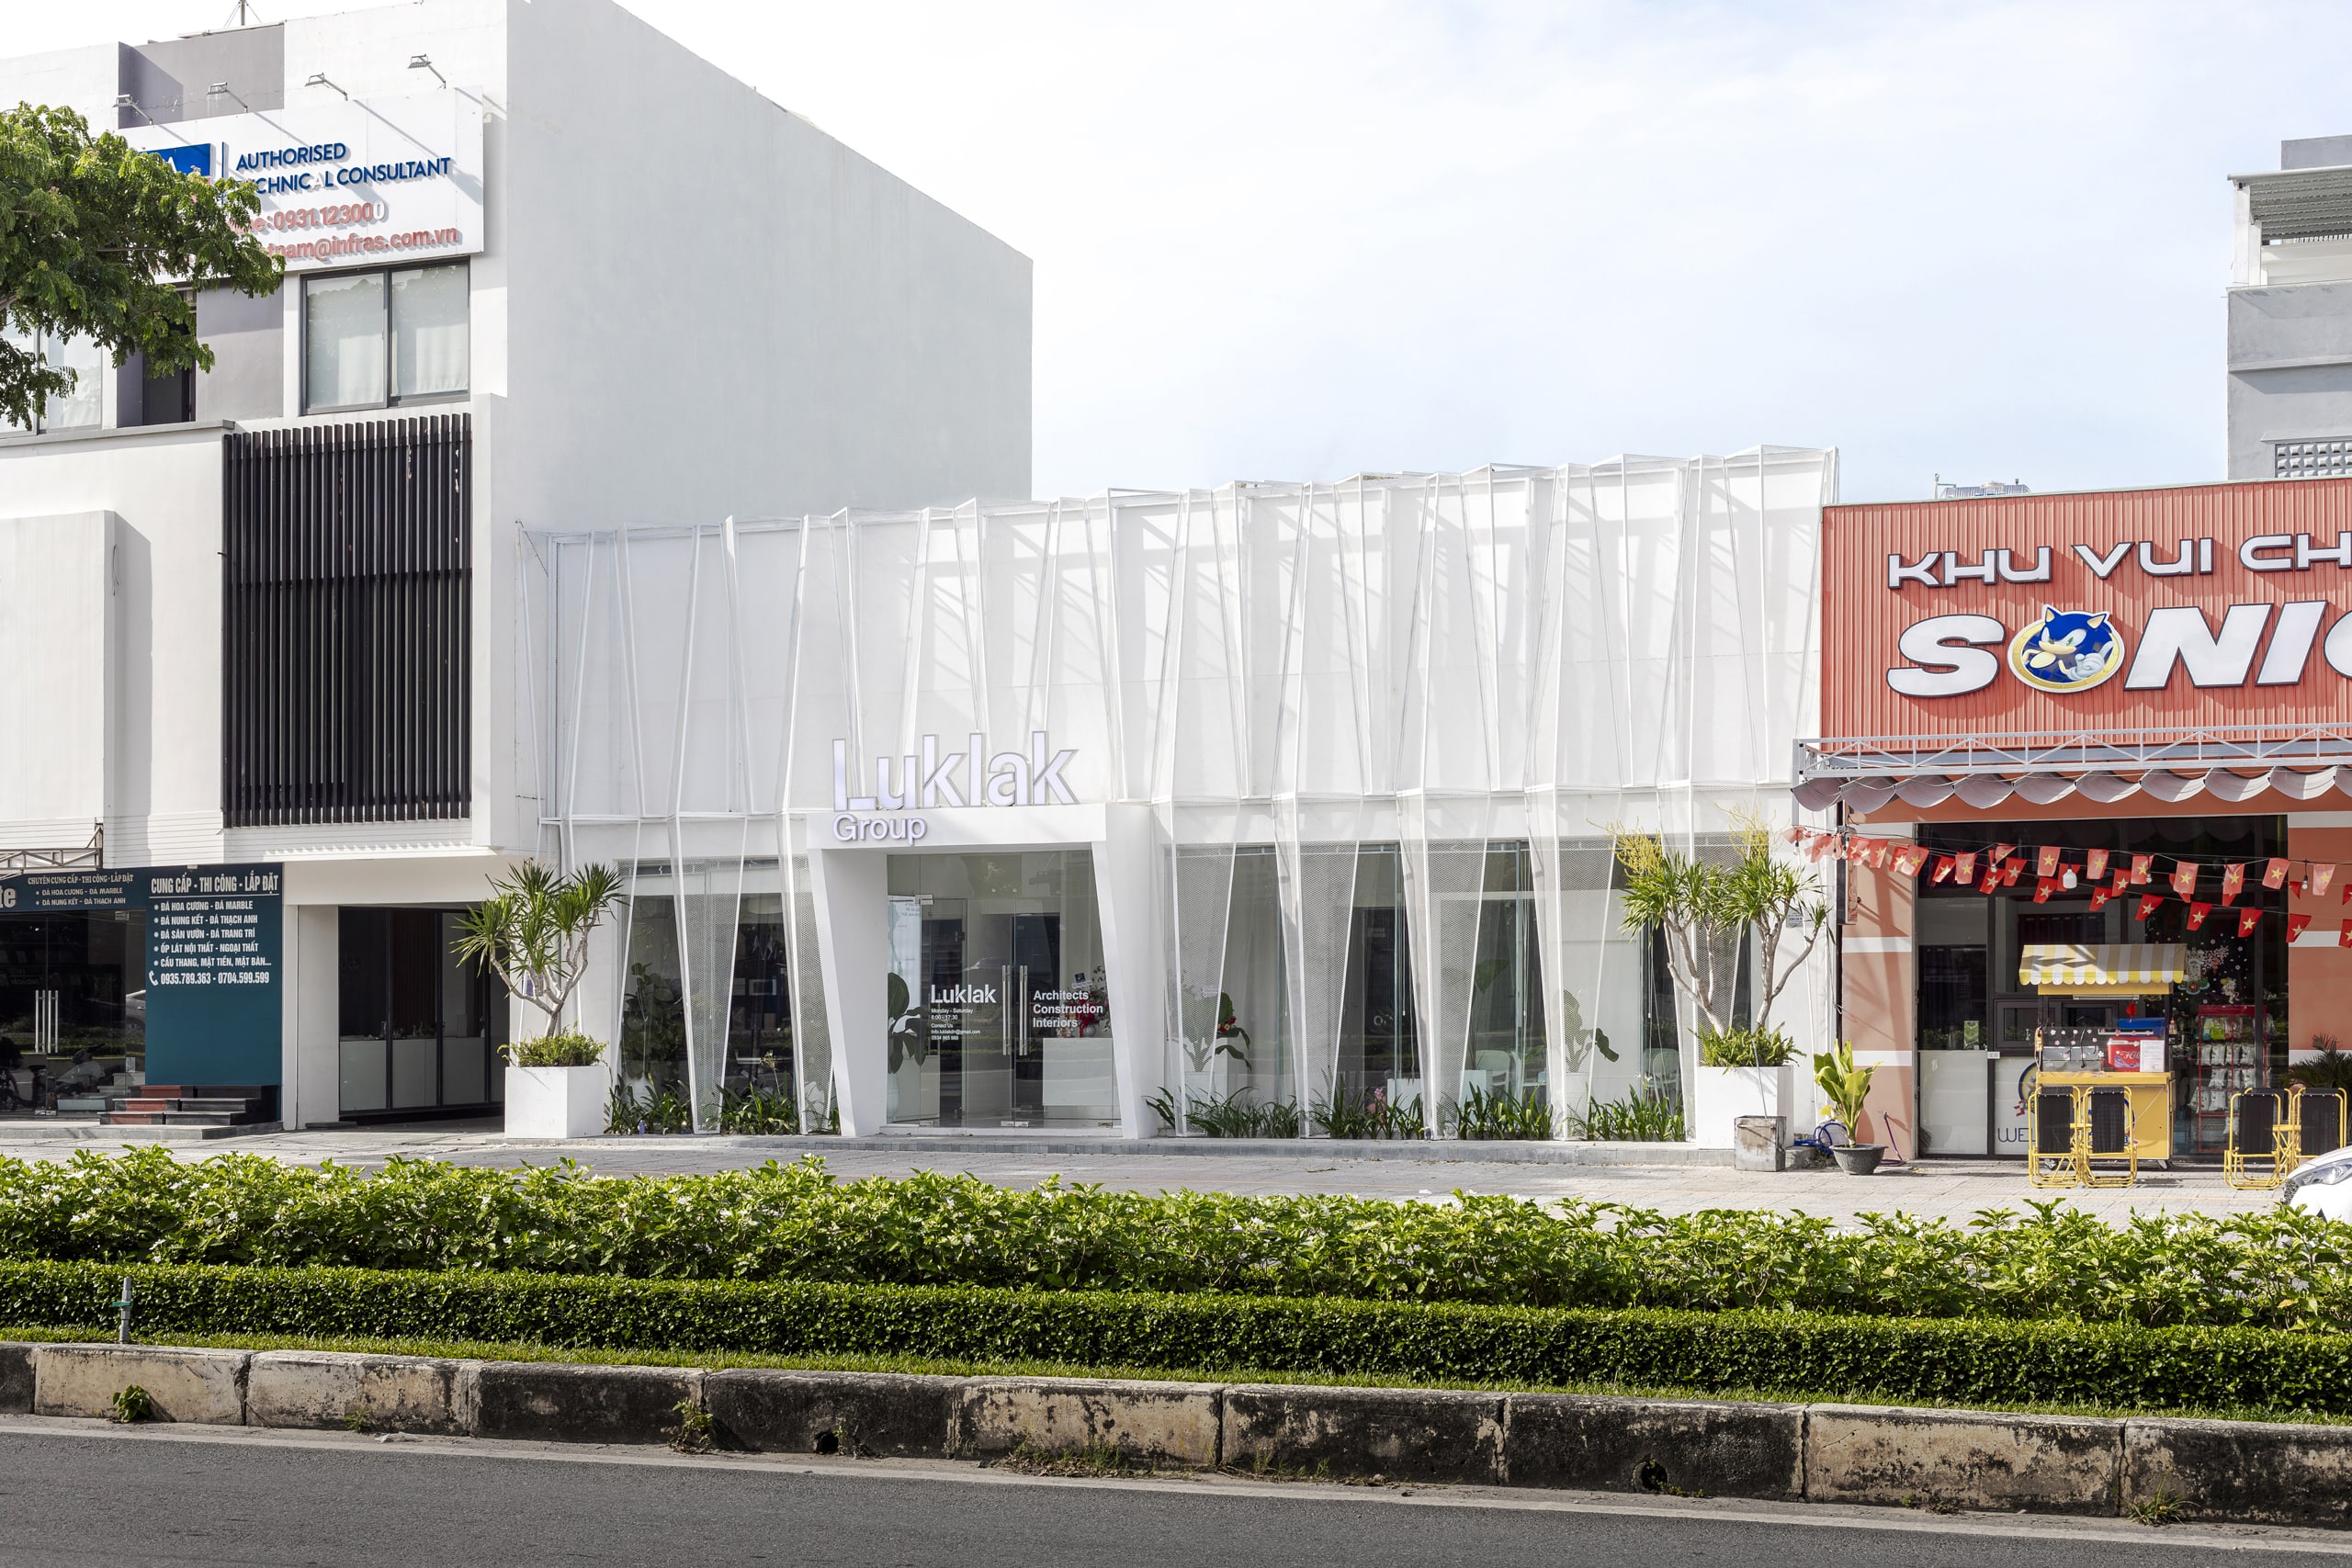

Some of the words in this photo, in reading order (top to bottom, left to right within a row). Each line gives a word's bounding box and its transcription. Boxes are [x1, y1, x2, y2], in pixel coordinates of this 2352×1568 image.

[236, 142, 346, 171] AUTHORISED
[238, 172, 334, 194] CHNICAL
[336, 157, 450, 186] CONSULTANT
[267, 226, 457, 261] tnam@infras.com.vn
[1887, 546, 2052, 589] KHU
[2072, 537, 2213, 580] VUI
[832, 731, 1079, 812] Luklak
[831, 813, 927, 845] Group
[151, 877, 174, 894] CUNG
[175, 872, 192, 893] CẤP
[199, 876, 212, 892] THI
[215, 873, 237, 892] CÔNG
[244, 870, 260, 891] LẮP
[262, 872, 278, 894] ĐẶT
[161, 900, 170, 911] ĐÁ
[171, 902, 185, 911] HOA
[215, 899, 224, 909] ĐÁ
[226, 900, 253, 909] MARBLE
[161, 915, 170, 925] ĐÁ
[171, 916, 190, 925] NUNG
[191, 913, 204, 924] KẾT
[209, 913, 219, 924] ĐÁ
[220, 915, 243, 926] THẠCH
[243, 915, 257, 924] ANH
[161, 929, 170, 939] ĐÁ
[210, 928, 220, 938] ĐÁ
[220, 929, 243, 938] TRANG
[244, 927, 255, 938] TRÍ
[161, 942, 170, 953] ỐP
[171, 942, 183, 953] LÁT
[184, 942, 197, 954] NỘI
[198, 941, 214, 953] THẤT
[220, 943, 241, 953] NGOẠI
[242, 941, 259, 952] THẤT
[175, 958, 199, 967] THANG,
[200, 956, 215, 968] MẶT
[235, 955, 250, 967] MẶT
[161, 973, 211, 985] 0935.789.363
[218, 971, 270, 984] 0704.599.599
[931, 985, 997, 1003] Luklak
[1034, 989, 1089, 1000] Architects
[1033, 1003, 1103, 1014] Construction
[1033, 1017, 1079, 1028] Interiors
[1997, 1127, 2036, 1142] WEL
